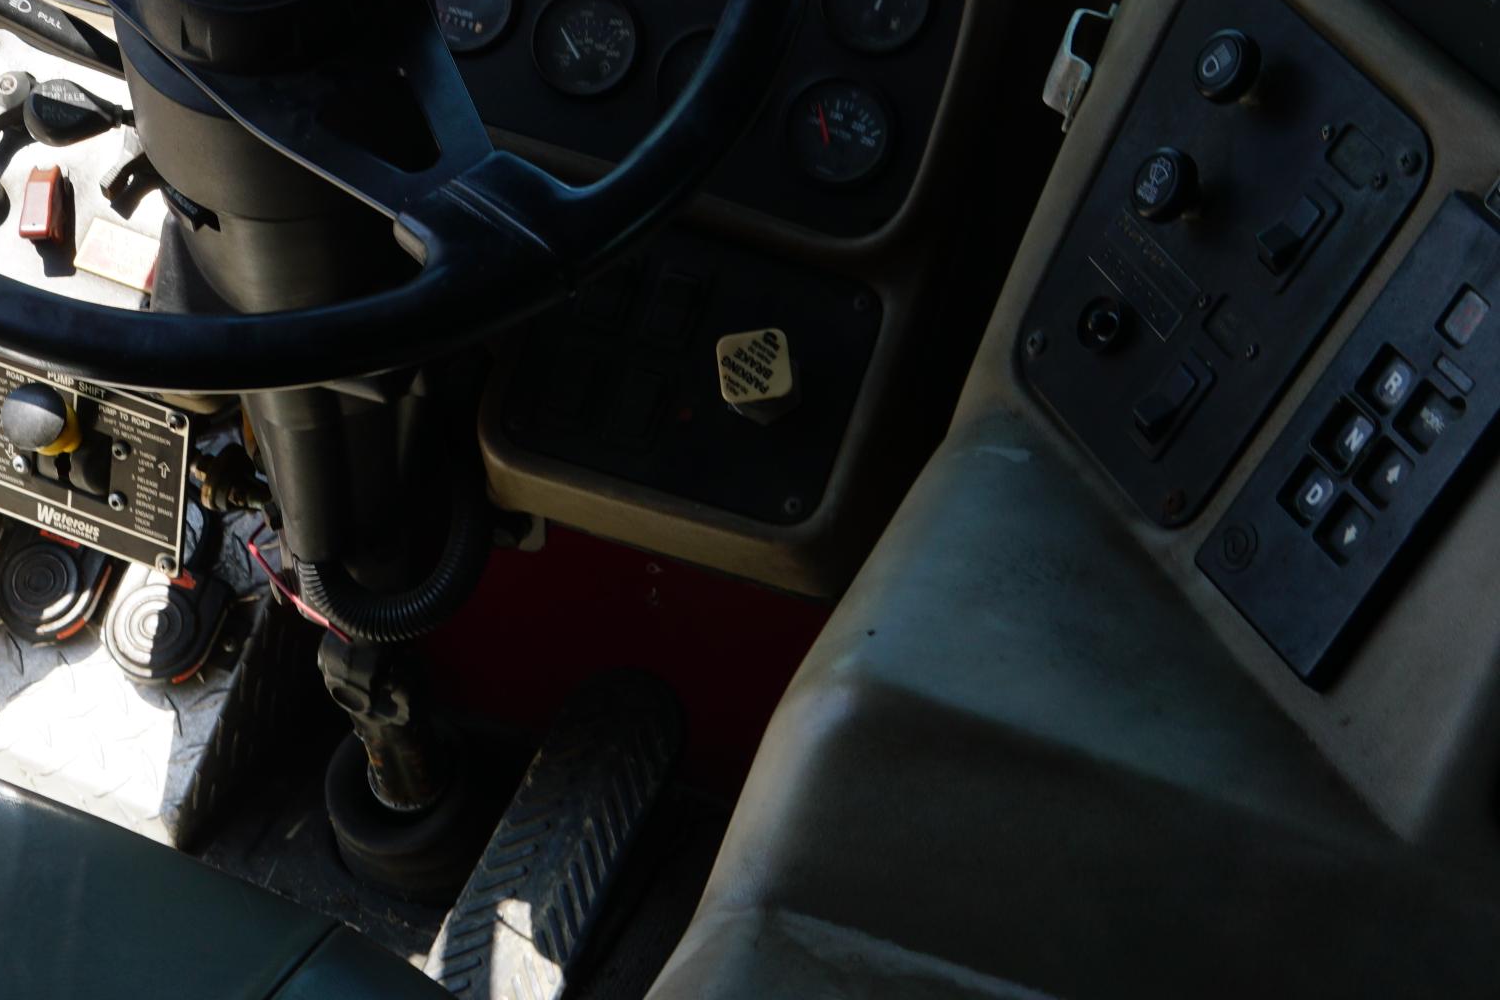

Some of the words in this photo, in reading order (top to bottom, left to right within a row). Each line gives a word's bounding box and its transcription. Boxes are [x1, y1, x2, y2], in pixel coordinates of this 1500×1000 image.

[37, 10, 62, 30] PULL
[721, 356, 769, 394] PARKING
[734, 347, 773, 379] BRAKE
[5, 370, 24, 383] ROAD
[47, 370, 75, 387] PUMP
[78, 381, 106, 400] SHIFT
[1384, 370, 1403, 396] R
[98, 404, 117, 417] PUMP
[119, 412, 128, 420] TO
[131, 416, 150, 429] ROAD
[1344, 426, 1364, 453] N
[1305, 482, 1323, 506] D
[37, 502, 100, 538] Waterous
